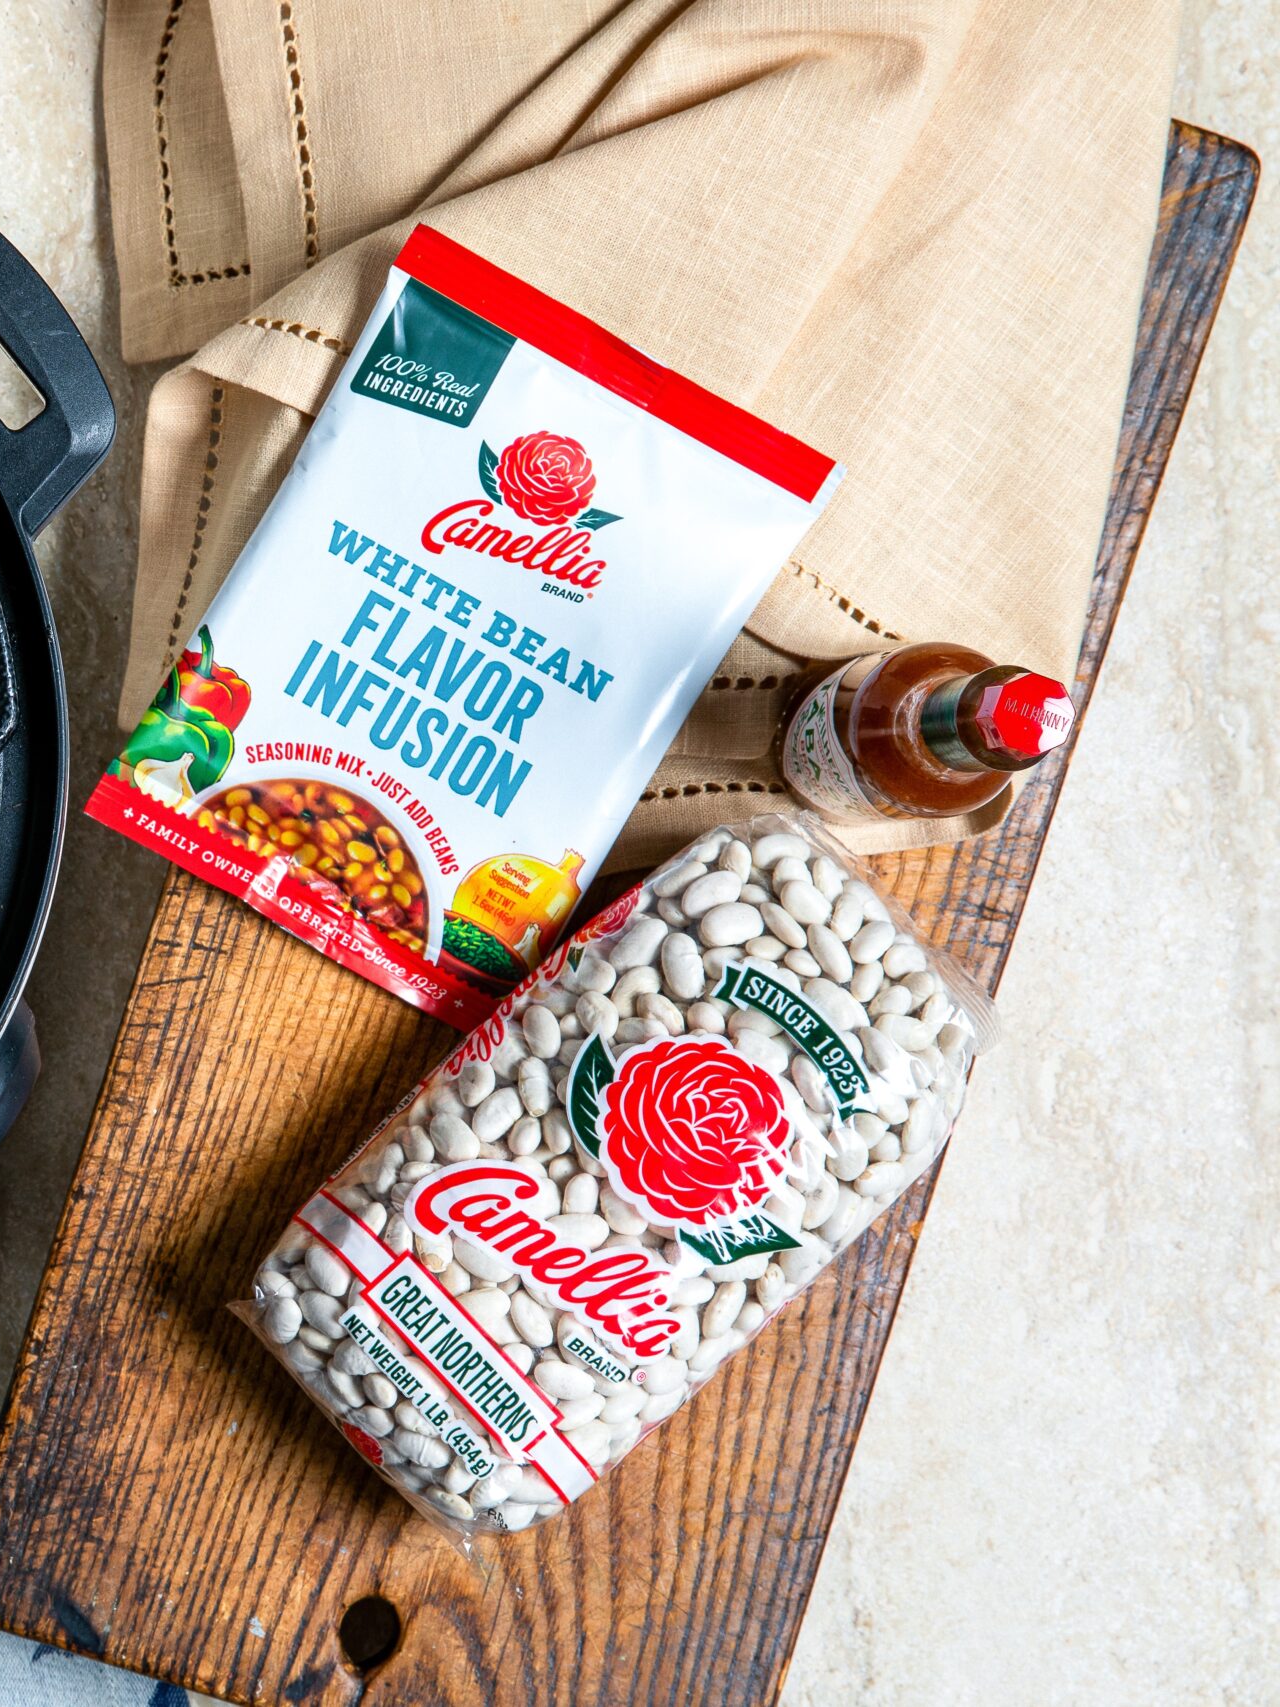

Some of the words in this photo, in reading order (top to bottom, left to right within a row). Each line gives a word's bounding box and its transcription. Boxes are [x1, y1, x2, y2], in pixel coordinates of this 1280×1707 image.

[363, 371, 468, 418] INGREDIENTS
[374, 353, 432, 382] 100%
[432, 371, 481, 398] Real
[421, 499, 606, 589] Camellia
[540, 582, 584, 604] BRAND
[332, 520, 481, 630] WHITE
[478, 610, 614, 702] BEAN
[341, 589, 544, 744] FLAVOR
[283, 639, 533, 818] INFUSION
[245, 742, 333, 766] SEASONING
[335, 751, 366, 778] MIX
[371, 772, 412, 805] JUST
[403, 799, 434, 830] ADD
[424, 826, 459, 876] BEANS
[135, 813, 200, 856] FAMILY
[279, 896, 362, 951] OPERATED
[362, 946, 407, 978] Since
[409, 973, 448, 1001] 1923
[489, 869, 530, 899] Suggestion
[502, 862, 531, 887] Serving
[744, 976, 819, 1039] SINCE
[812, 1035, 864, 1094] 1923
[414, 1167, 681, 1357] Camellia
[344, 1314, 375, 1345] NET
[368, 1339, 423, 1396] WEIGHT
[417, 1392, 431, 1407] 1
[425, 1403, 449, 1432] LB.
[445, 1426, 494, 1478] (454g)
[380, 1275, 450, 1345] GREAT
[429, 1327, 538, 1443] NORTHERNS
[567, 1337, 626, 1383] BRAND
